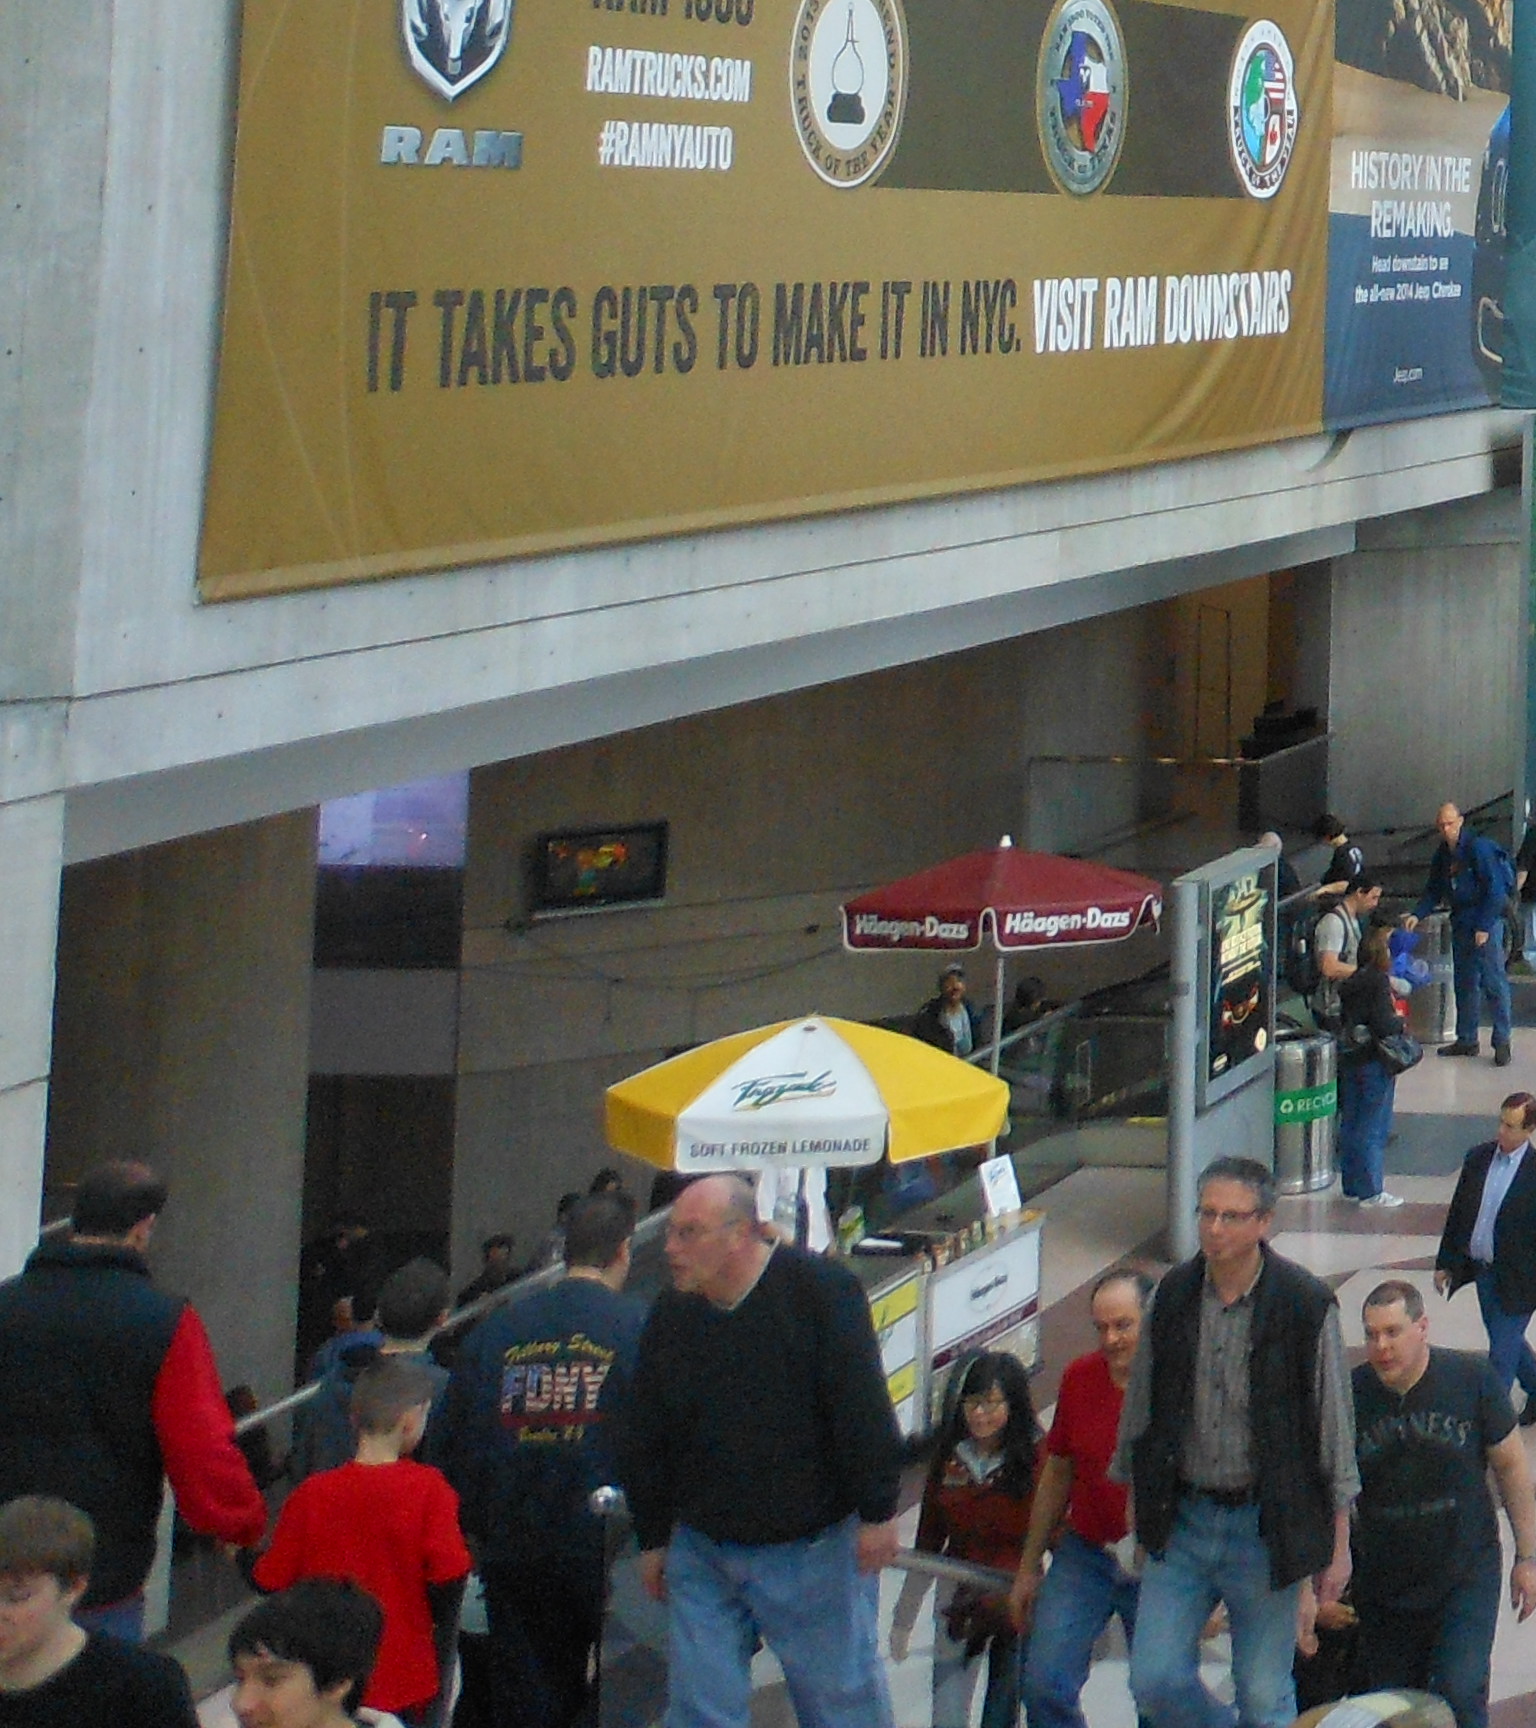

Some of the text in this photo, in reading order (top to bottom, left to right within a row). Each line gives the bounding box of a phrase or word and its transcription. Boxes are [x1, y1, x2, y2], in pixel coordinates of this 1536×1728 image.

[587, 45, 751, 102] RAMTRUCKS.COM
[380, 125, 523, 168] RAM
[599, 121, 733, 170] #RAMNYAUTO
[826, 154, 839, 175] OF
[1351, 151, 1471, 193] HISTORY IN THE
[1370, 200, 1455, 239] REMAKING.
[367, 290, 417, 392] IT
[433, 286, 577, 388] TAKES
[591, 284, 698, 380] GUTS
[713, 281, 760, 370] TO
[773, 280, 869, 367] MAKE
[880, 280, 912, 359] IT
[921, 280, 950, 357] IN
[959, 279, 1021, 356] NYC.
[1032, 277, 1098, 354] VISIT
[1103, 275, 1158, 349] RAM
[690, 1138, 870, 1158] SOFT FROZEN LEMONADE
[501, 1363, 611, 1412] FDNY
